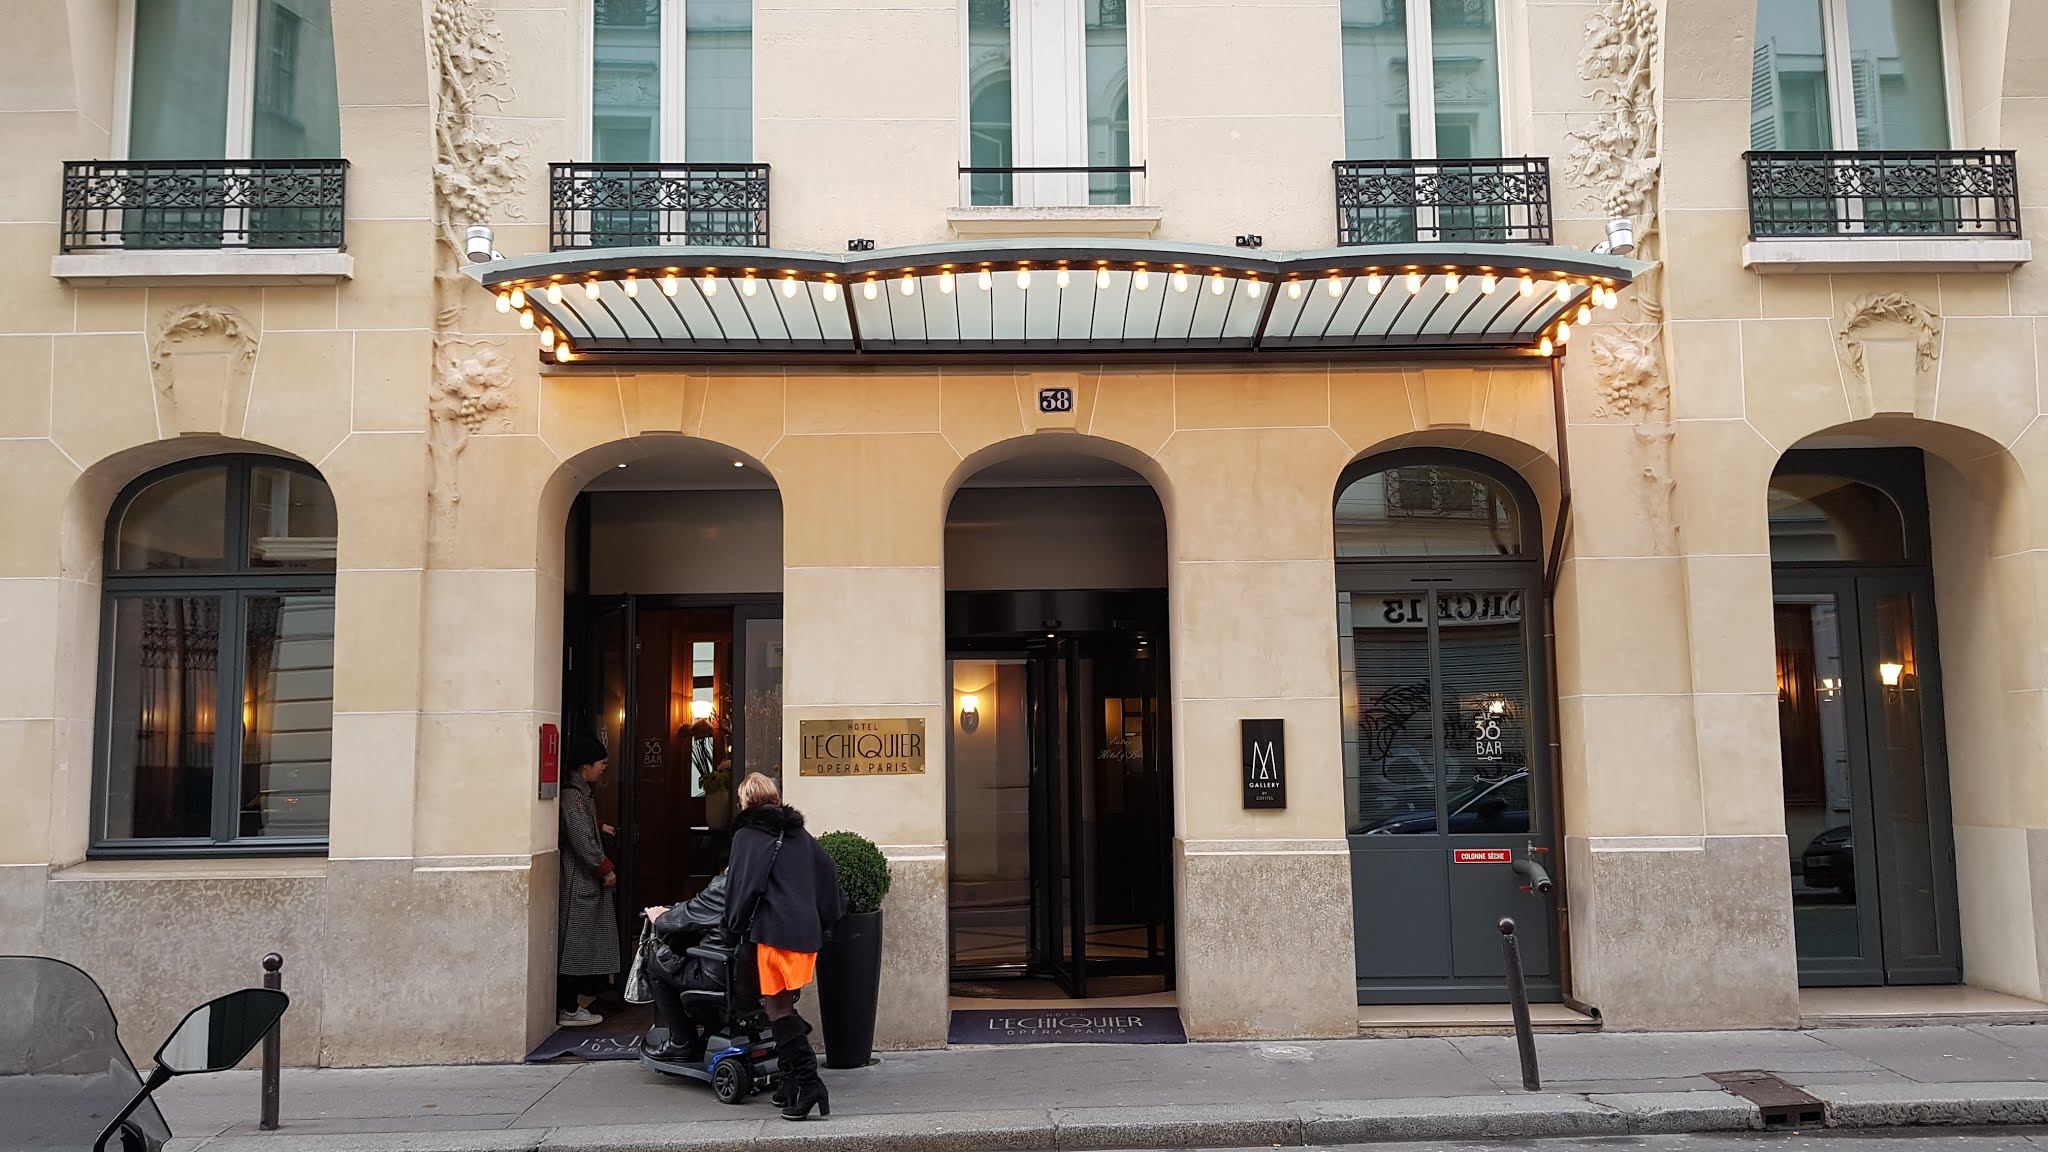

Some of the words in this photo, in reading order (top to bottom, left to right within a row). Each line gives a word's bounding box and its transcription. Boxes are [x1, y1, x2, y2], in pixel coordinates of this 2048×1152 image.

[1042, 391, 1070, 410] 38
[1483, 712, 1491, 720] LE
[847, 723, 878, 731] HOTEL
[1474, 720, 1501, 740] 38
[548, 734, 557, 755] H
[644, 741, 662, 755] 38
[803, 733, 921, 759] L'ECHIQUIER
[1476, 741, 1502, 755] BAR
[644, 754, 662, 765] BAR
[817, 763, 860, 774] OPERA
[868, 762, 908, 772] PARIS
[989, 1016, 1143, 1030] L'ECHIQUIER
